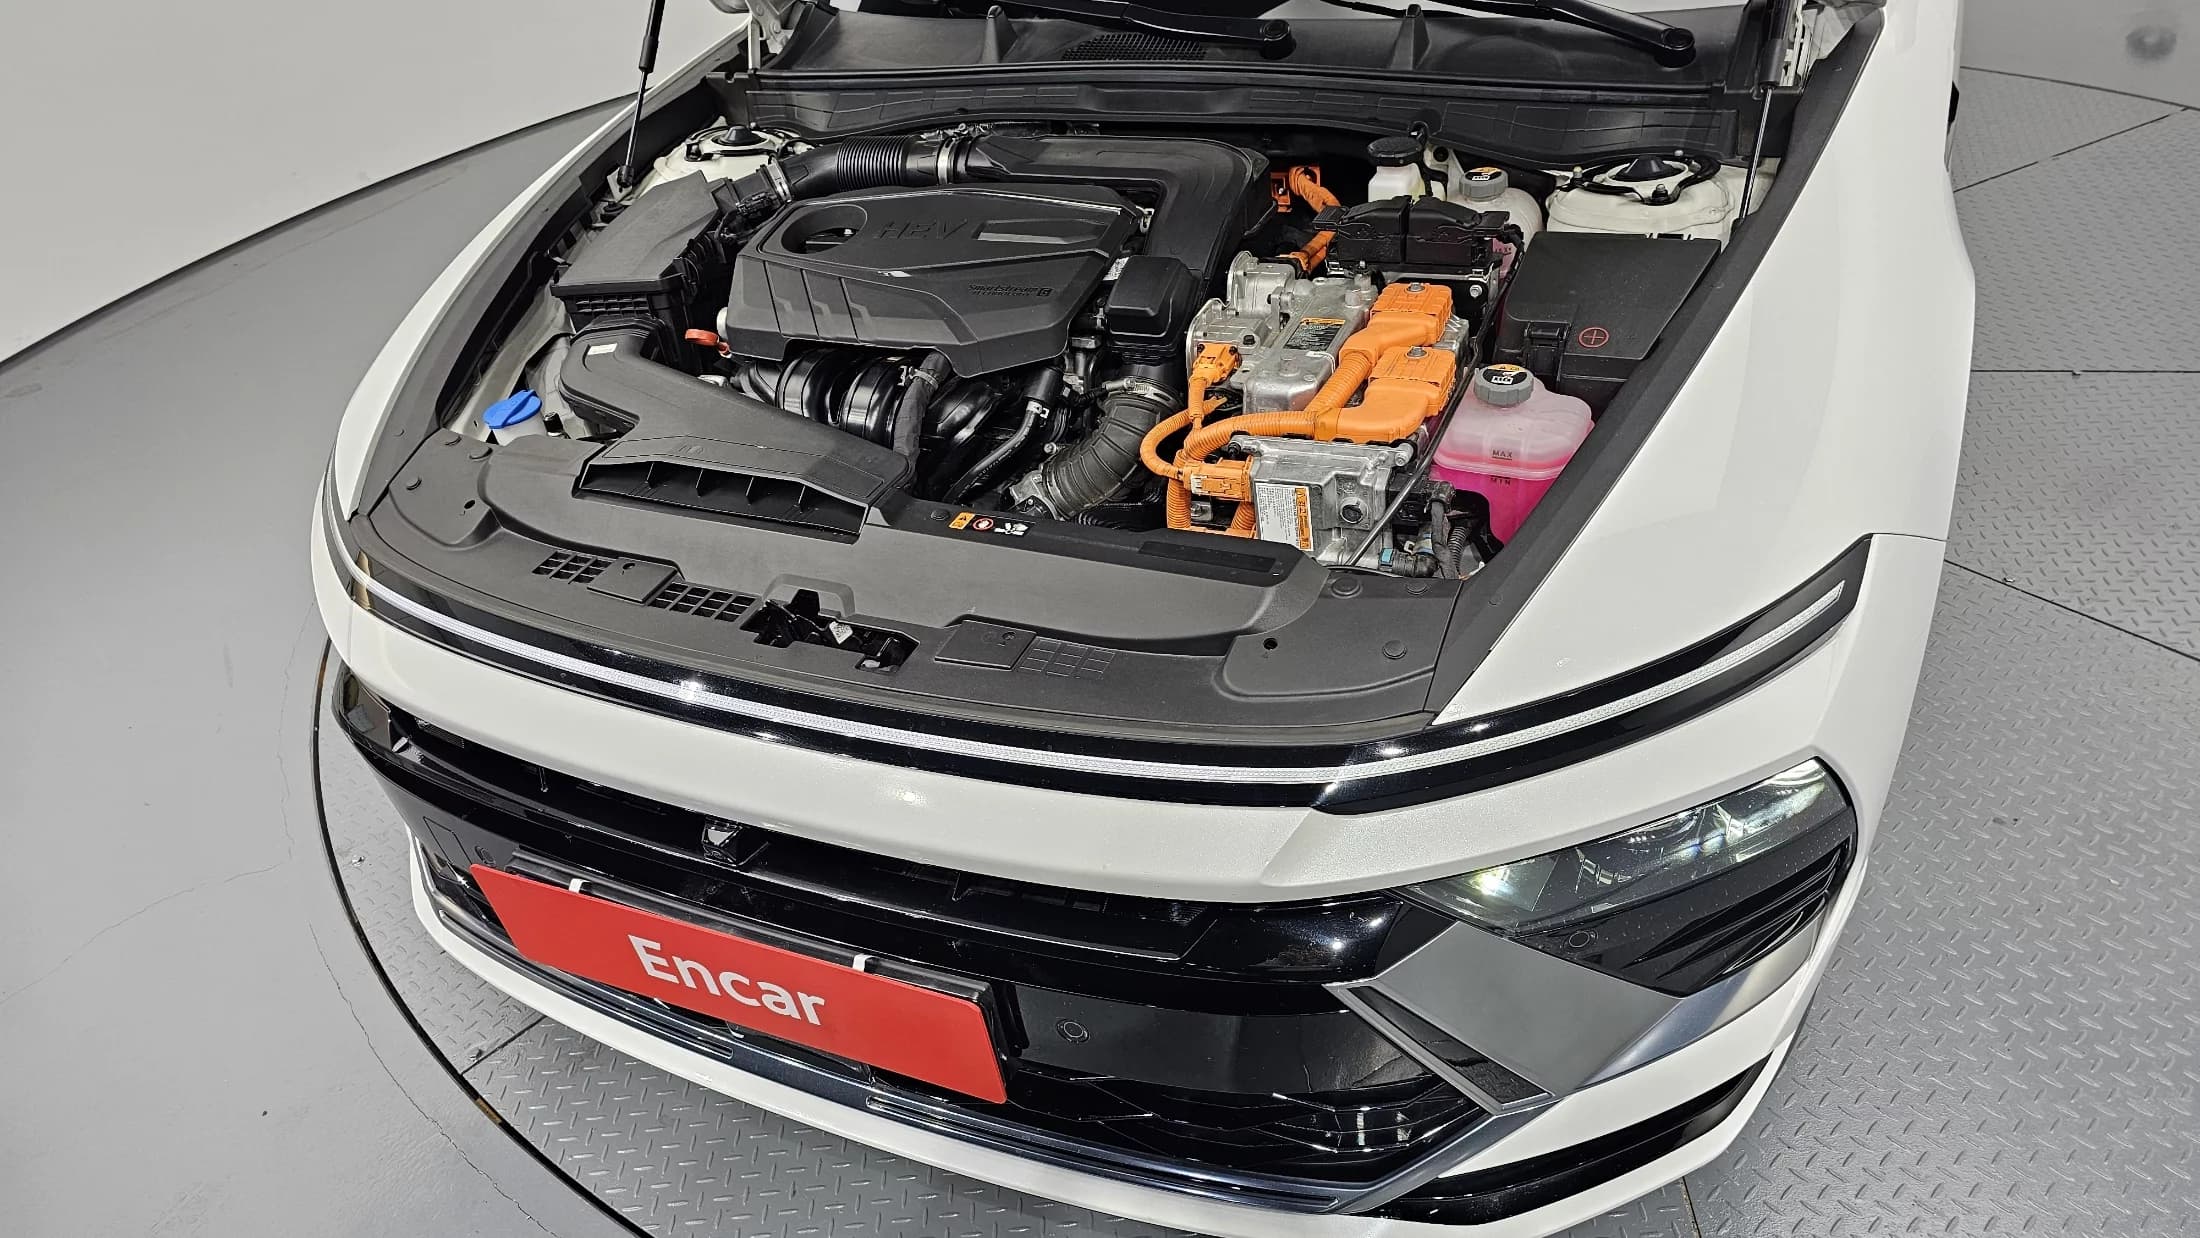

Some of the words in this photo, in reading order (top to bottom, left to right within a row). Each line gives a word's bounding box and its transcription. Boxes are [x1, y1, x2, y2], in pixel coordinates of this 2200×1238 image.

[872, 217, 968, 240] HEV
[1492, 450, 1513, 458] MAX
[627, 934, 825, 1026] Encar
